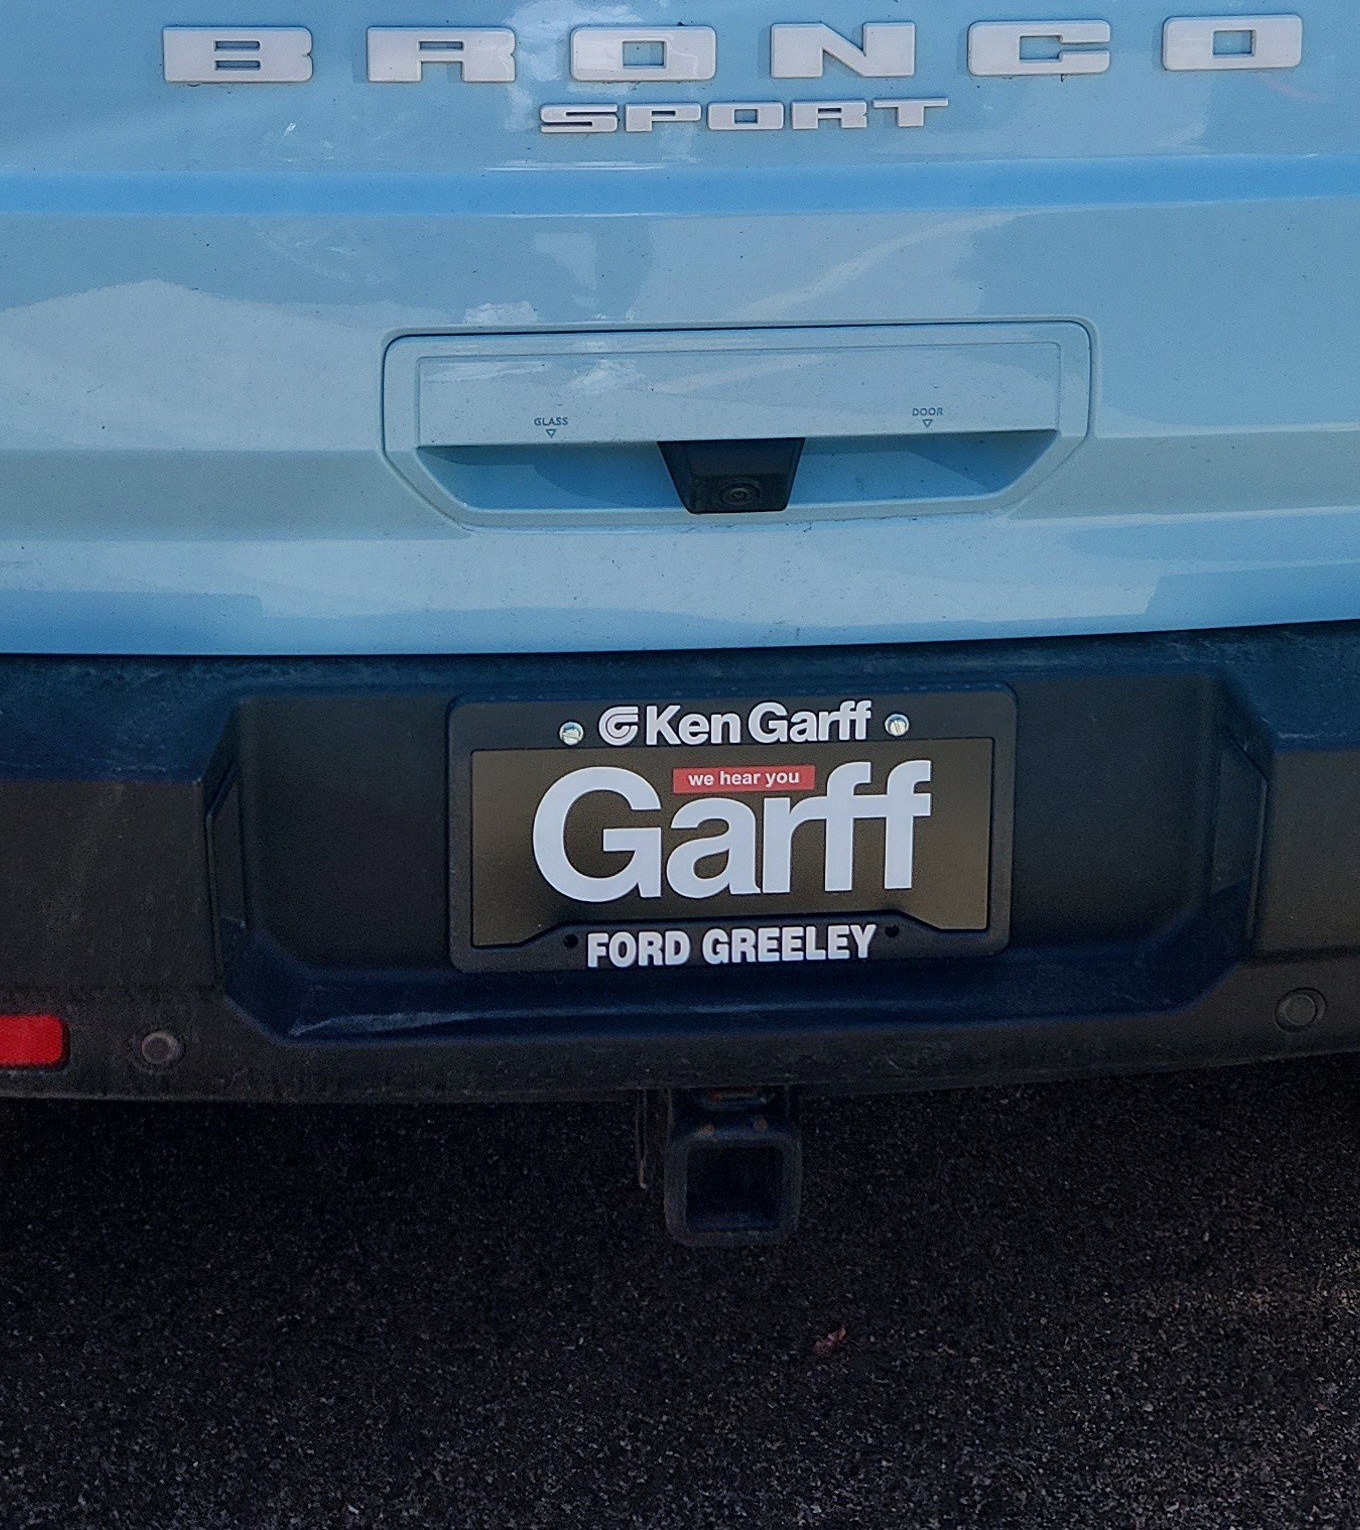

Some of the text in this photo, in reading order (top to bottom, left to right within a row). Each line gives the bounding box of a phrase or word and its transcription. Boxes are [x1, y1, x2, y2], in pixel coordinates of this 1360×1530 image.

[161, 13, 1304, 83] BRONCO
[538, 96, 950, 134] SPORT
[533, 416, 569, 426] GLASS
[912, 406, 944, 416] DOOR
[645, 699, 872, 746] Ken Garff
[688, 769, 800, 788] we hear you
[532, 759, 932, 903] Garff
[586, 923, 877, 969] FORD GREELEY
